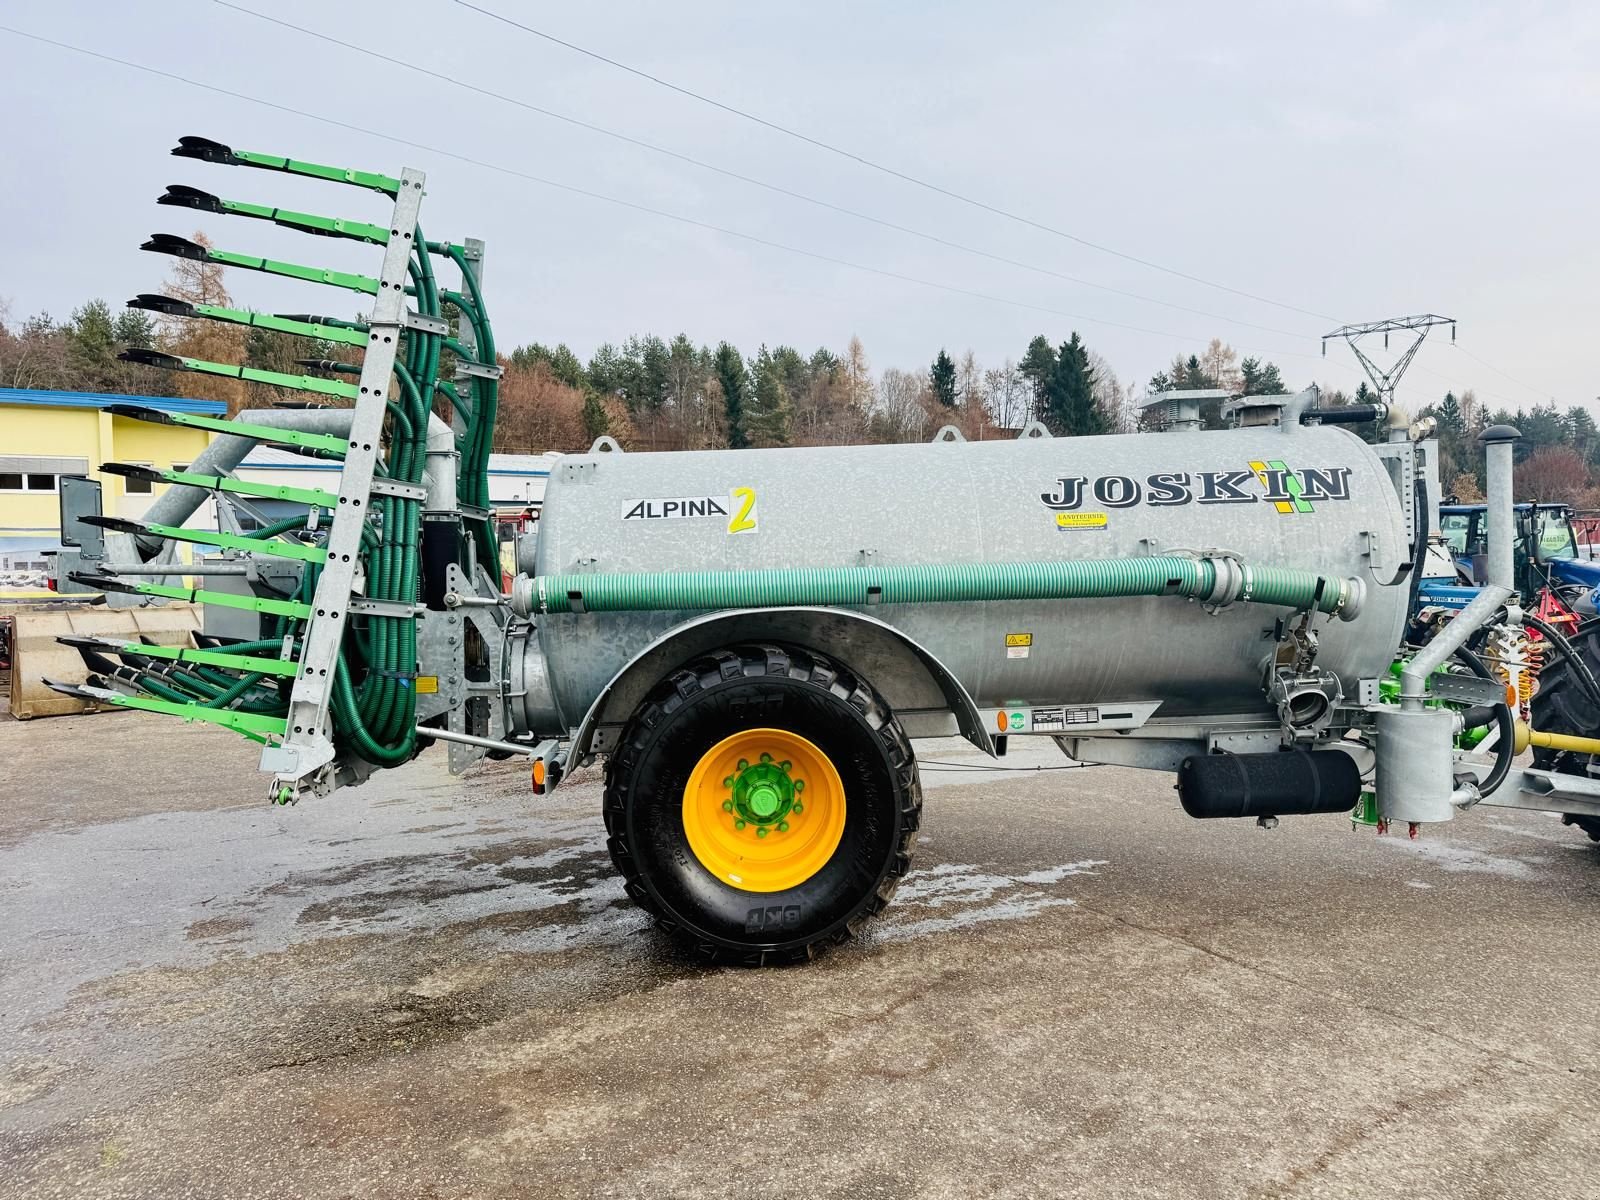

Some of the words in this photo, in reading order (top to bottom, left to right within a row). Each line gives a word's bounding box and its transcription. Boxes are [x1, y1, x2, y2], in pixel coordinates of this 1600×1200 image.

[624, 498, 728, 519] ALPINA
[728, 486, 756, 533] 2
[1041, 467, 1352, 510] JOSKIN
